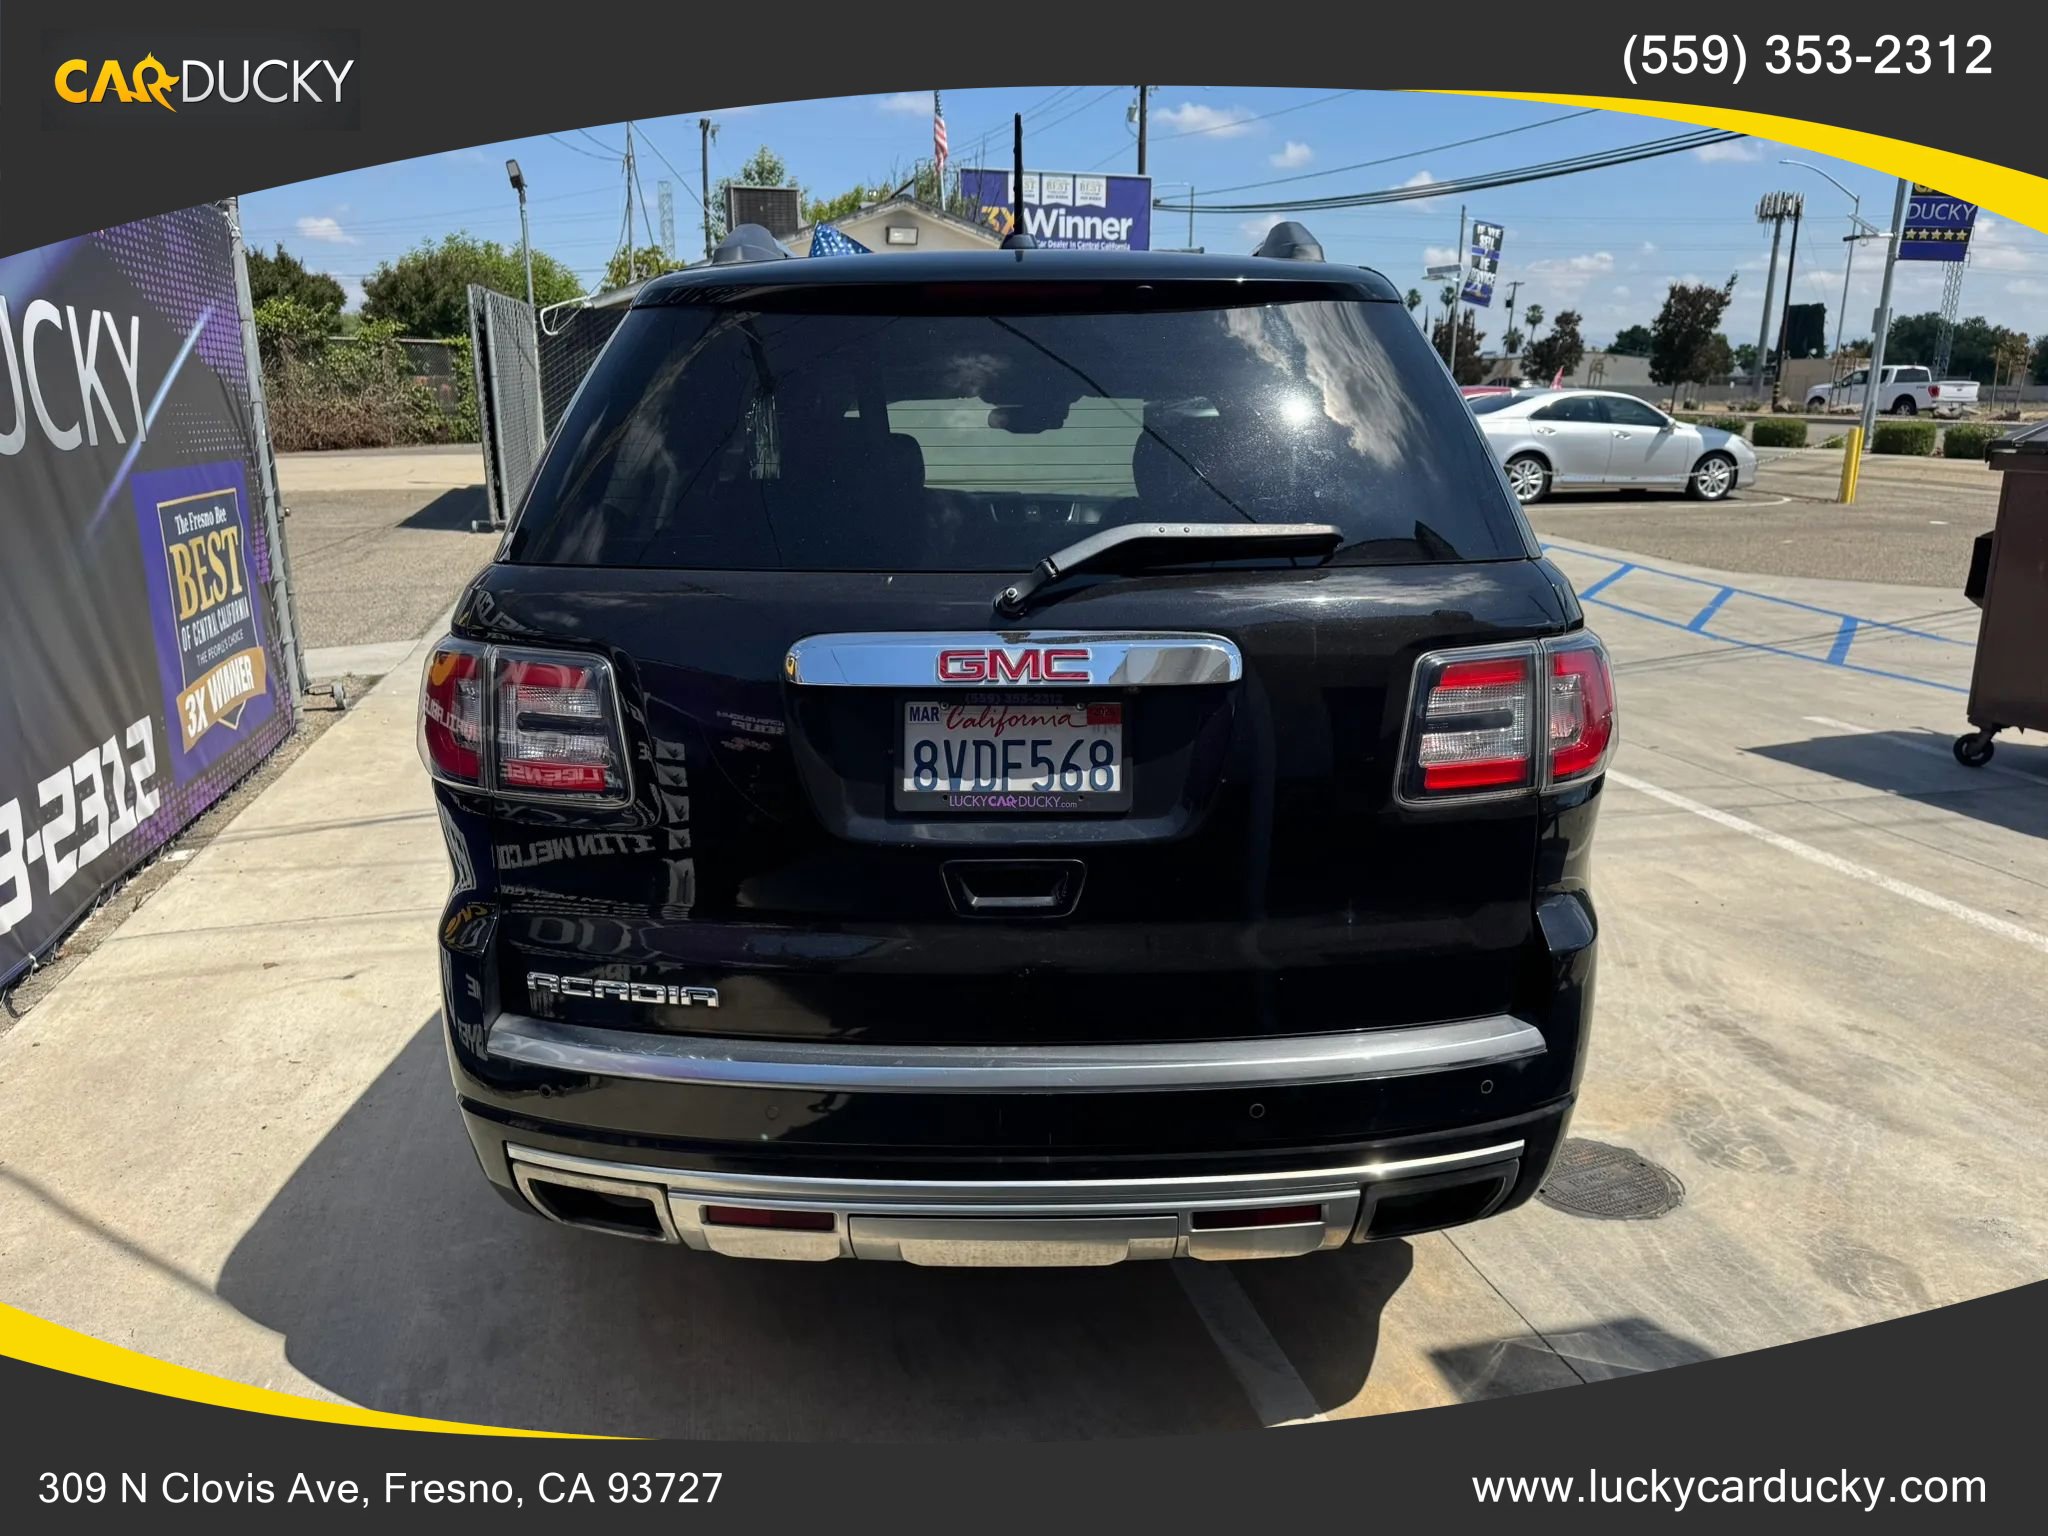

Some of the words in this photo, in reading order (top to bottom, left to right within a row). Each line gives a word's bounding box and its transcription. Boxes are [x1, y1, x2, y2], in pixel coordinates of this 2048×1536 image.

[1023, 207, 1133, 241] Winner
[1906, 202, 1977, 221] DUCKY
[1077, 240, 1099, 250] Central
[174, 514, 190, 535] The
[188, 509, 215, 532] Fresno
[214, 505, 227, 524] Bee
[168, 525, 243, 621] BEST
[181, 624, 192, 652] OF
[192, 610, 220, 647] CENTRAL
[216, 596, 250, 633] CALIFORNIA
[937, 649, 1091, 683] GMC
[185, 685, 208, 738] 3X
[207, 654, 255, 714] WINNER
[909, 706, 940, 722] MAR
[947, 704, 1088, 738] California
[913, 739, 1114, 792] 8VDF568
[527, 972, 719, 1007] ACADIA
